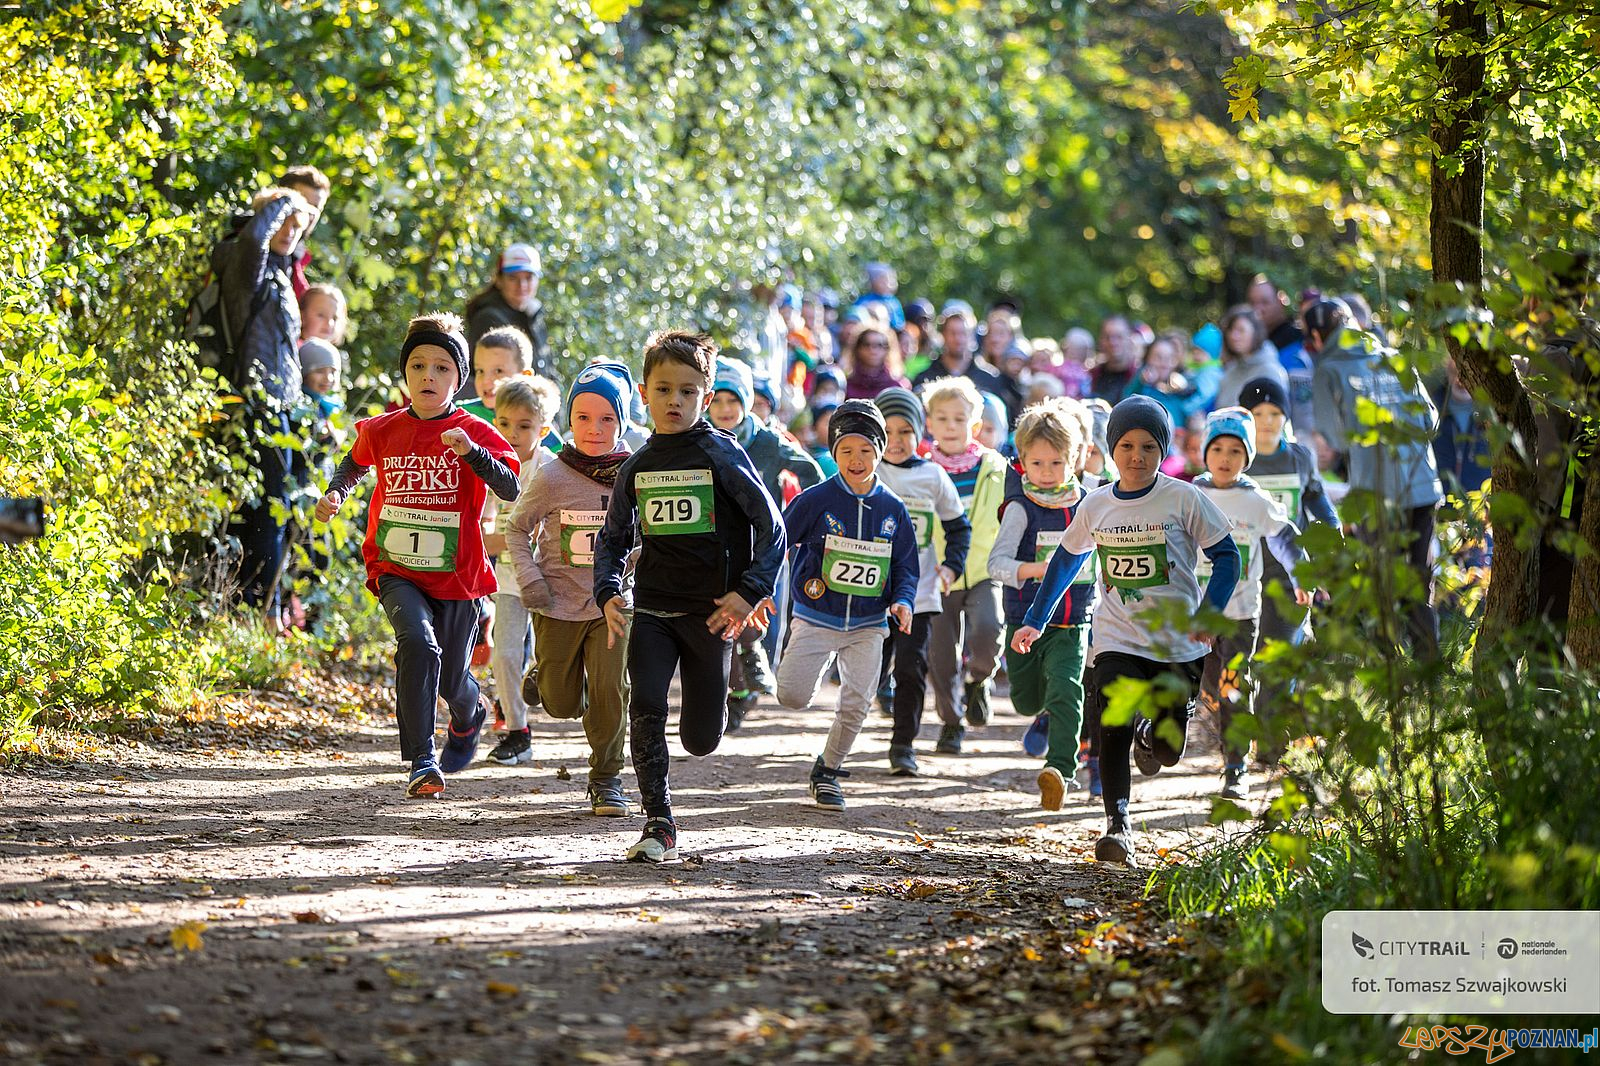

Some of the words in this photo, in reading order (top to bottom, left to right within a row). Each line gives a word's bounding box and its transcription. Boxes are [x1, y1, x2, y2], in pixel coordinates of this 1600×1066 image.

[383, 453, 448, 470] DRUŻYNA
[385, 468, 461, 492] SZPIKU
[682, 474, 704, 482] Junior
[384, 494, 457, 506] www.darszpiku.pl
[430, 515, 452, 523] Junior
[651, 499, 693, 523] 219
[1145, 522, 1174, 532] Junior
[409, 532, 420, 553] 1
[397, 556, 430, 566] WOJCIECH
[1110, 557, 1150, 578] 225
[836, 562, 877, 586] 226
